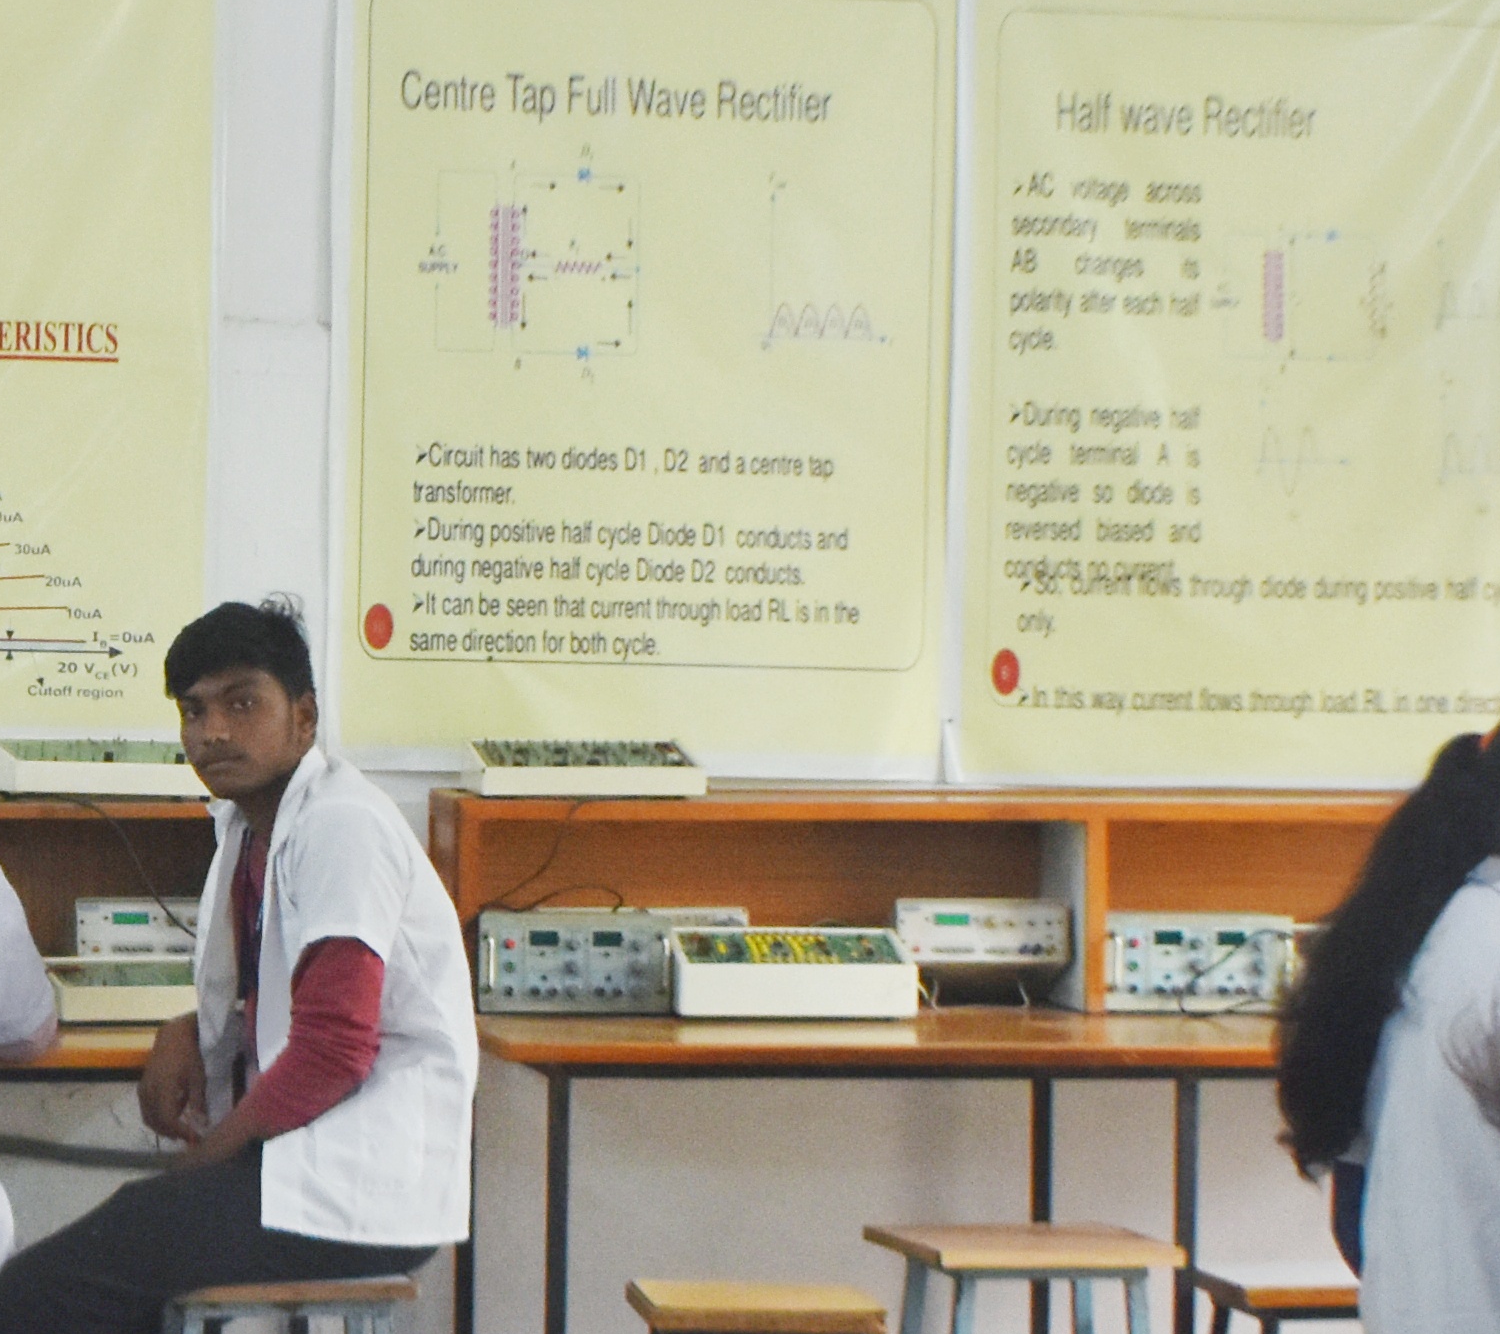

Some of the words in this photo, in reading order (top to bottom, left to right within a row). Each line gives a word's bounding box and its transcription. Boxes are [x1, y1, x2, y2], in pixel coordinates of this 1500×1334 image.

[400, 68, 496, 112] Centre
[505, 72, 556, 125] Tap
[567, 74, 618, 117] Full
[627, 77, 706, 120] Wave
[717, 79, 833, 124] Rectifier
[1056, 91, 1112, 134] Half
[1121, 102, 1193, 136] wave
[1203, 93, 1316, 139] Rectifier
[428, 441, 484, 468] Circuit
[490, 444, 520, 469] has
[526, 446, 556, 469] two
[561, 445, 618, 471] diodes
[663, 447, 689, 473] D2
[698, 450, 731, 475] and
[735, 455, 745, 475] a
[750, 455, 803, 477] centre
[809, 456, 834, 481] tap
[413, 479, 516, 505] transformer.
[14, 543, 51, 556] 30uA
[427, 517, 485, 548] During
[490, 519, 556, 546] positive
[561, 519, 593, 545] half
[597, 520, 641, 550] cycle
[647, 522, 696, 547] Diode
[702, 523, 726, 547] D1
[736, 525, 812, 551] conducts
[817, 527, 849, 551] and
[45, 576, 82, 588] 20uA
[411, 552, 466, 584] during
[471, 554, 544, 585] negative
[550, 555, 581, 580] half
[586, 557, 630, 586] cycle
[636, 557, 686, 583] Diode
[691, 559, 716, 584] D2
[425, 591, 436, 616] It
[442, 596, 473, 617] can
[478, 592, 500, 617] be
[506, 597, 547, 618] seen
[554, 594, 585, 618] that
[590, 597, 651, 620] current
[656, 597, 721, 627] through
[725, 598, 762, 623] load
[768, 598, 790, 623] RL
[834, 600, 860, 625] the
[410, 631, 457, 652] same
[462, 627, 536, 653] direction
[542, 629, 564, 653] for
[570, 630, 607, 655] both
[612, 632, 660, 662] cycle.
[57, 662, 77, 674] 20
[27, 685, 72, 698] Cutoff
[76, 687, 123, 701] region
